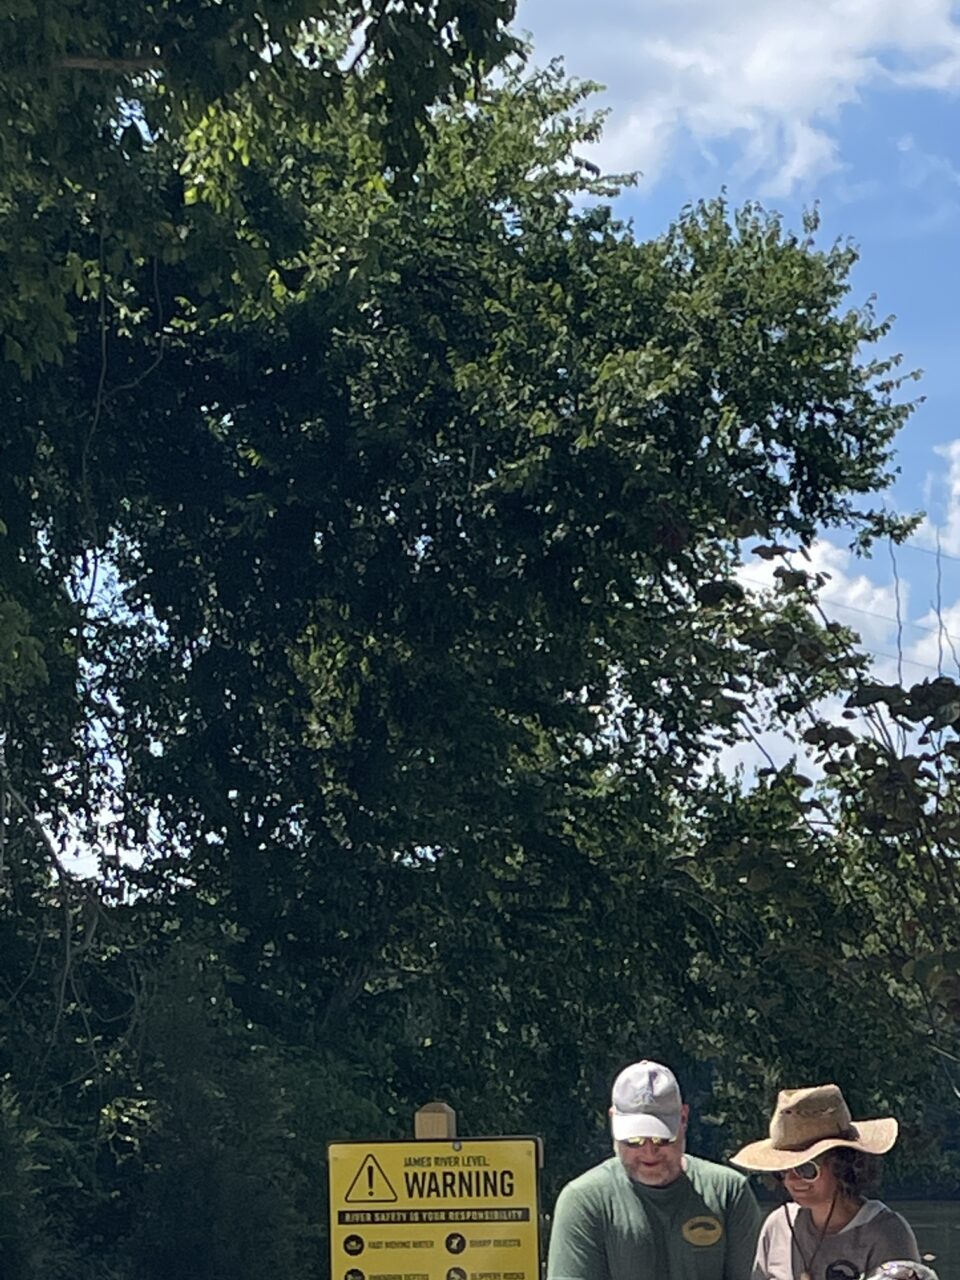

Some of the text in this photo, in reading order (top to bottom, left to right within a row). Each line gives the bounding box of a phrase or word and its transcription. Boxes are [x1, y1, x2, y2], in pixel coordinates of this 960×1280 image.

[404, 1156, 432, 1167] JAMES
[434, 1156, 460, 1167] RIVER
[404, 1170, 514, 1199] WARNING
[374, 1212, 407, 1222] SAFETY
[422, 1211, 446, 1221] YOUR
[448, 1210, 523, 1221] RESPONSIBILITY
